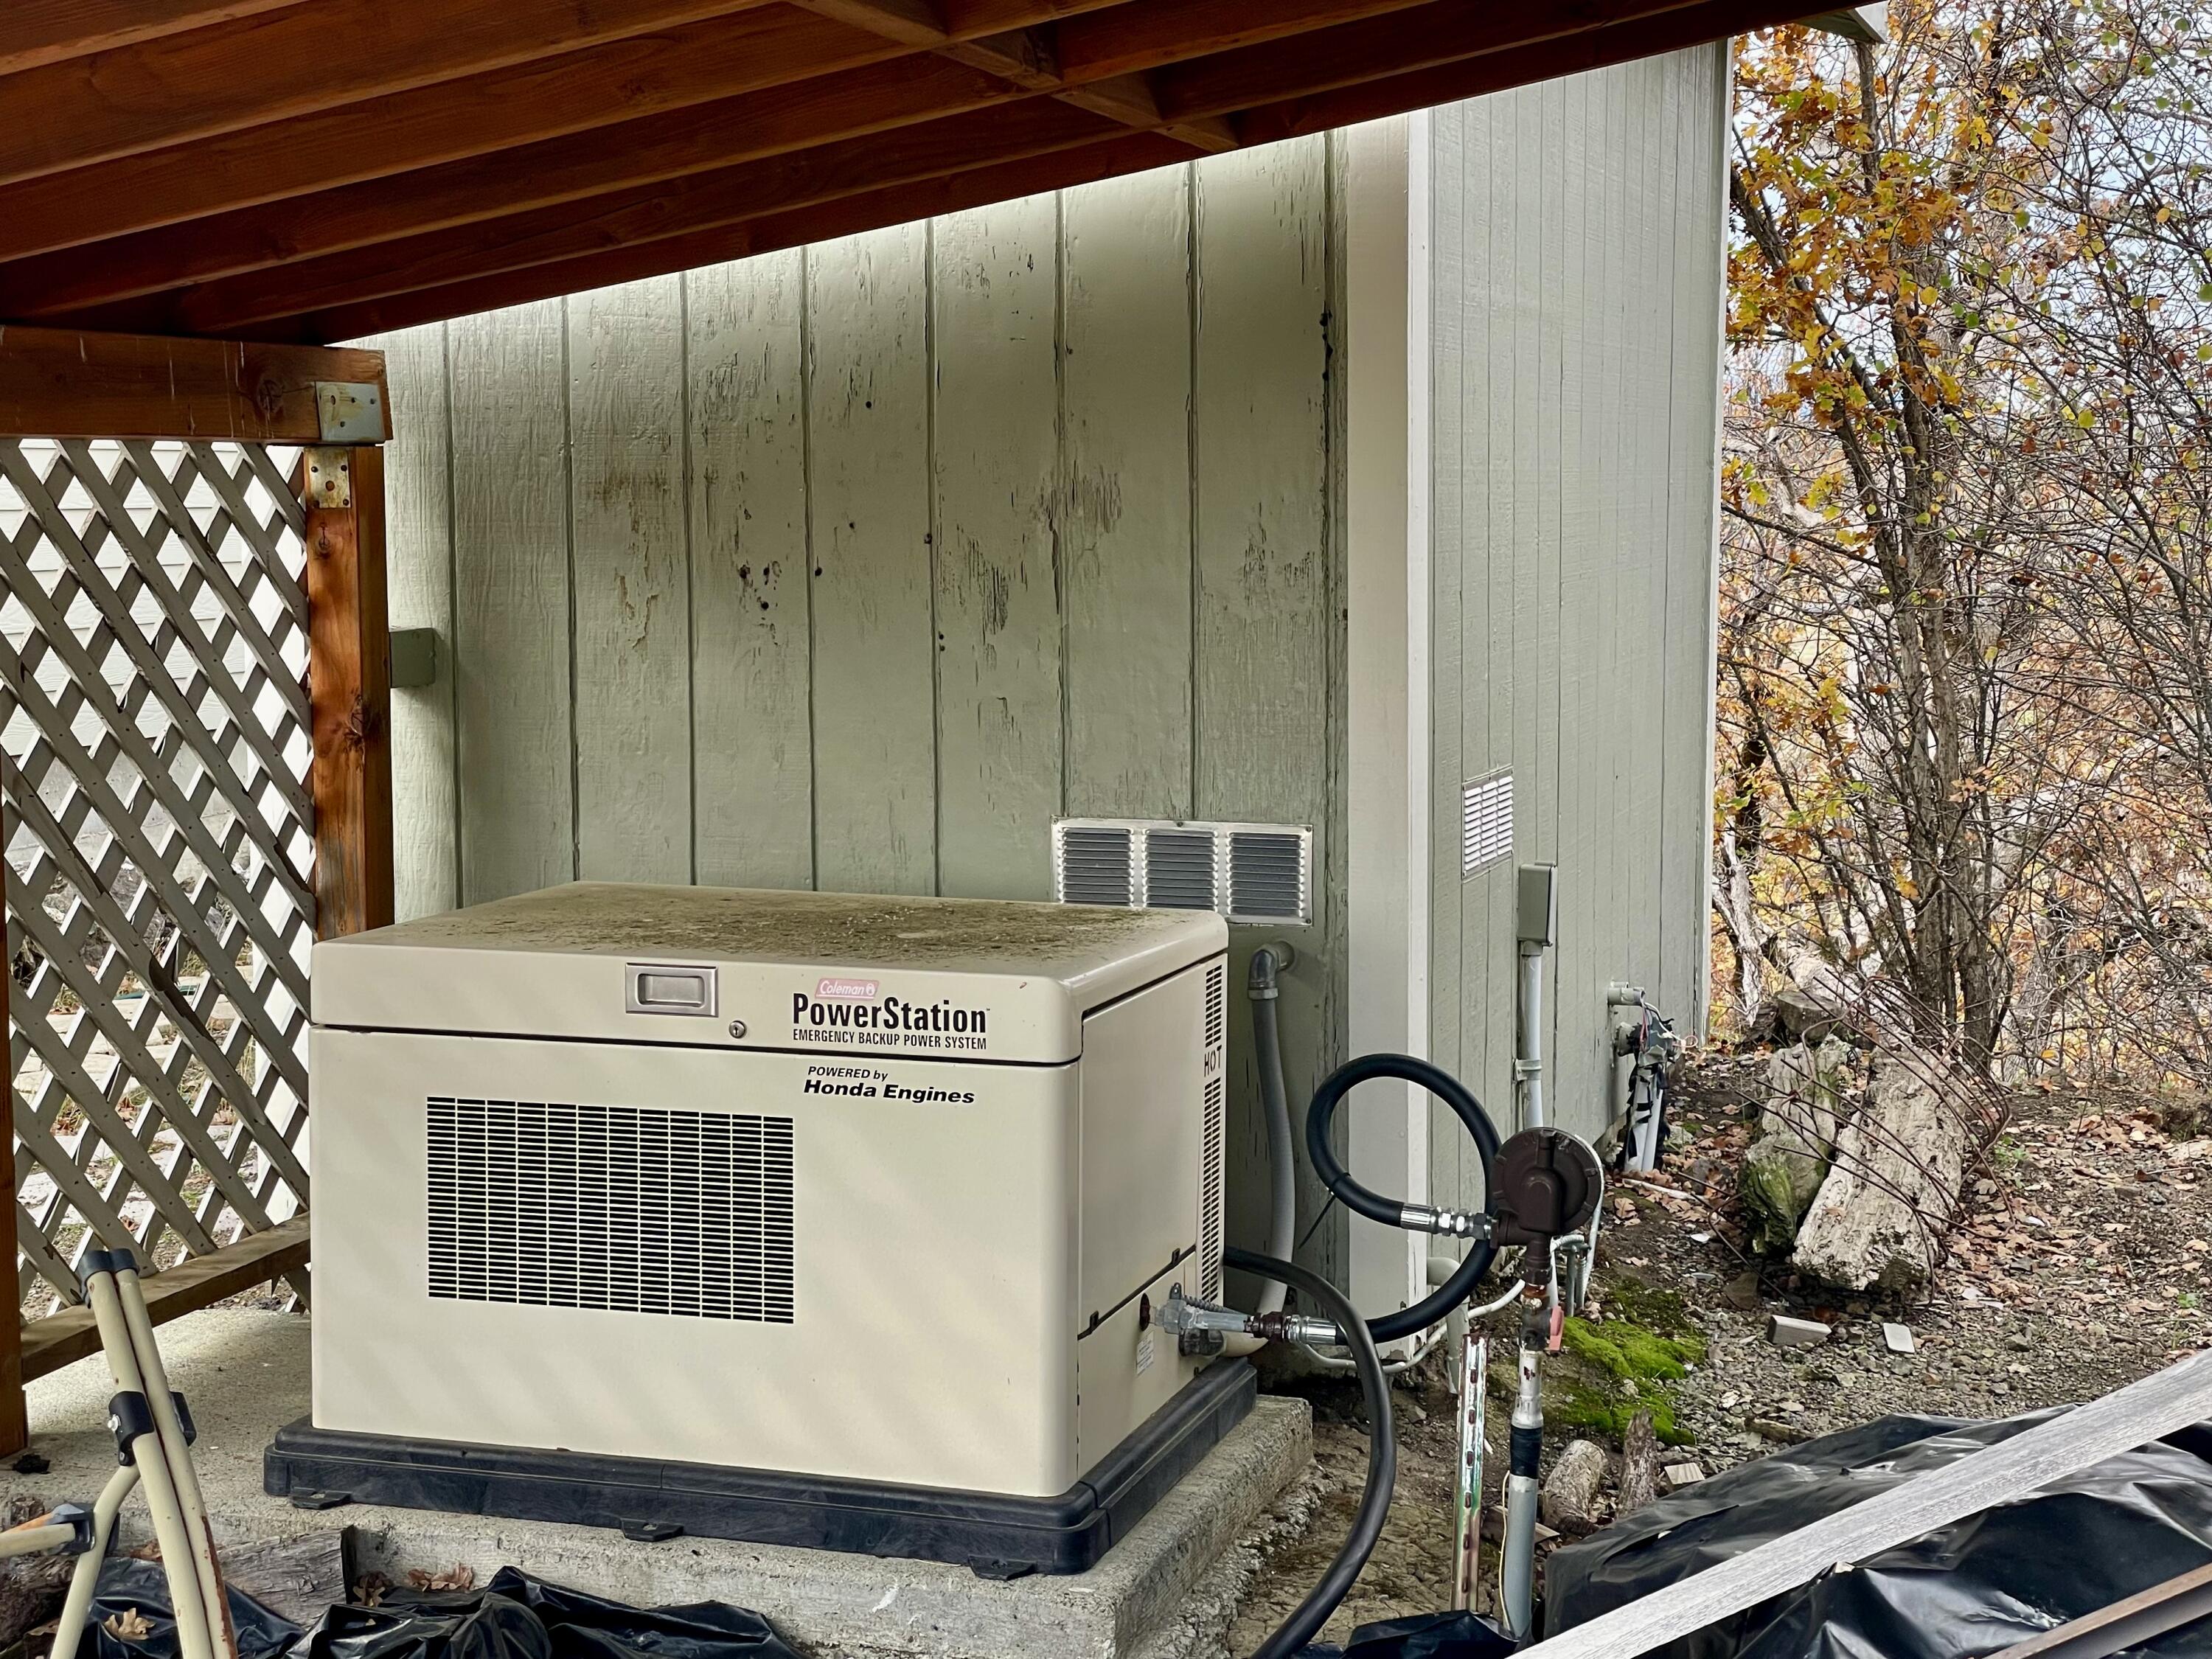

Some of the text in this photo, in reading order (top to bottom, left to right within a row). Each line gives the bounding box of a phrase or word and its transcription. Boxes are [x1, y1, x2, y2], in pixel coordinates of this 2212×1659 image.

[819, 980, 866, 995] Coleman
[793, 992, 986, 1033] PowerStation
[793, 1029, 987, 1050] EMERGENCY BACKUP POWER SYSTEM
[1203, 1044, 1222, 1078] HOT
[807, 1066, 888, 1082] POWERED by
[804, 1079, 975, 1104] Honda Engines
